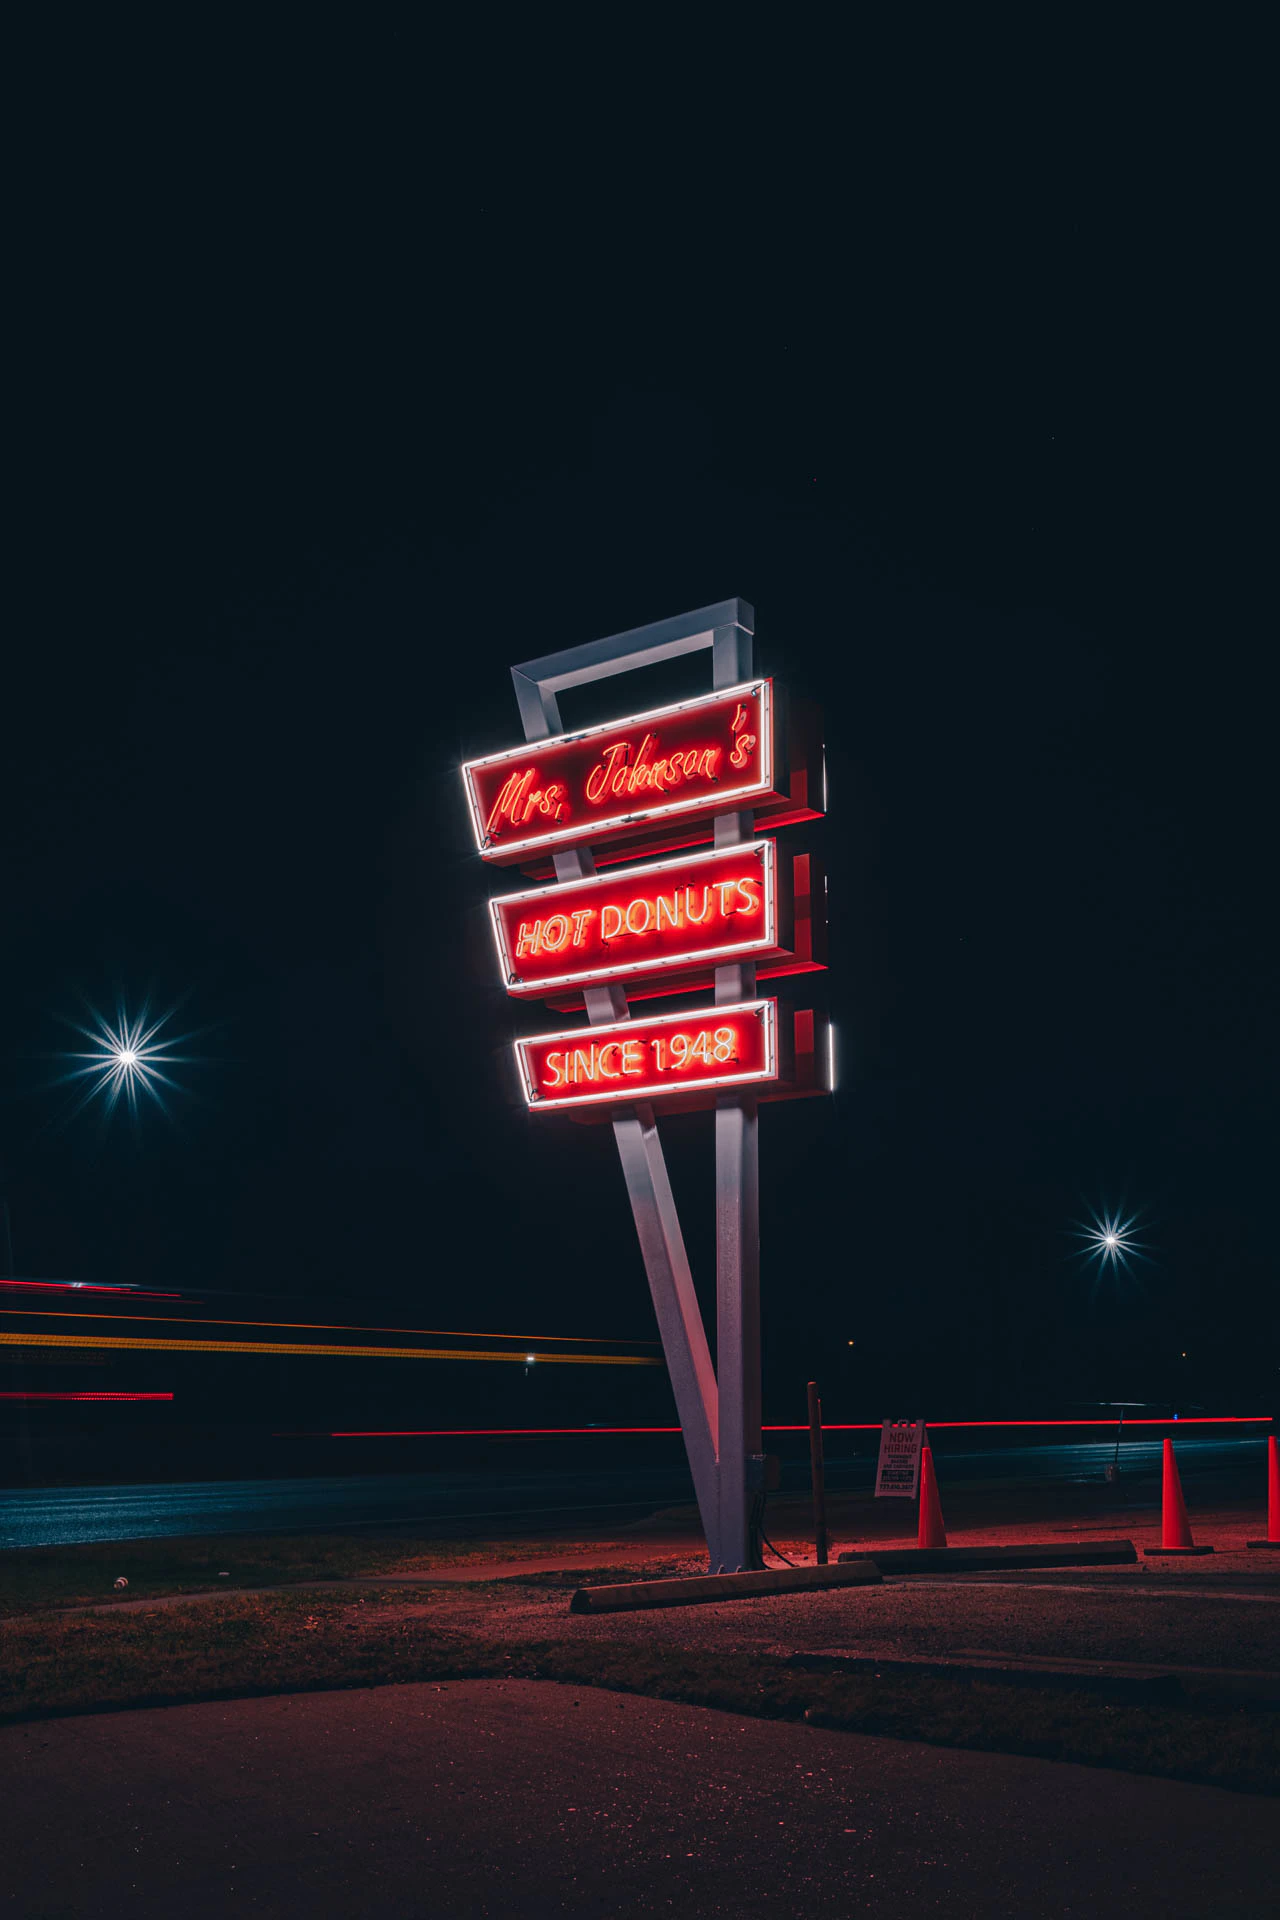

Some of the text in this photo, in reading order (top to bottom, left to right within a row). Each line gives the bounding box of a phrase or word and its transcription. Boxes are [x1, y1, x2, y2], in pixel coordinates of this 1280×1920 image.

[586, 704, 752, 800] Johnson's
[516, 877, 760, 957] HOT DONUTS
[542, 1027, 734, 1086] SINCE 1948
[883, 1443, 917, 1454] HIRING
[889, 1432, 914, 1443] NOW
